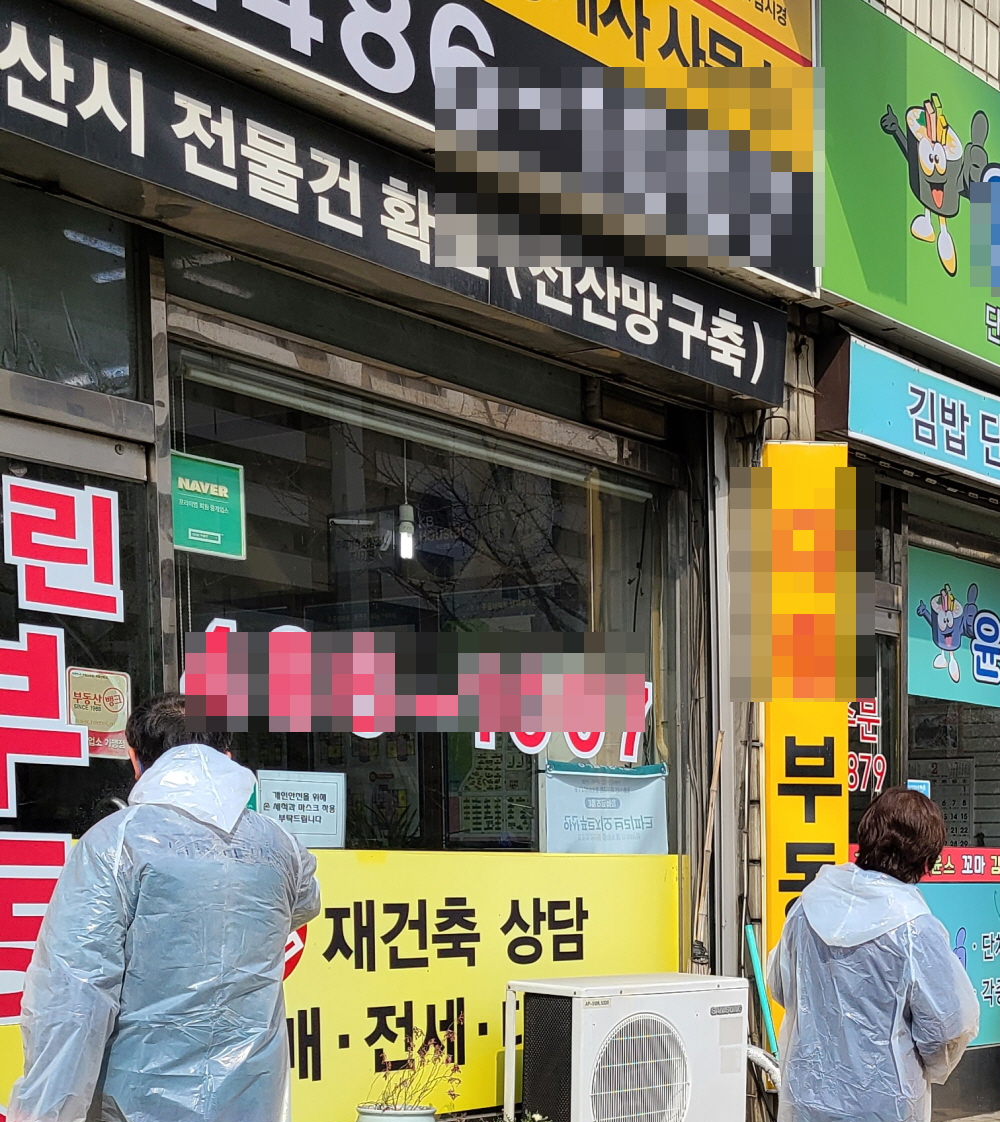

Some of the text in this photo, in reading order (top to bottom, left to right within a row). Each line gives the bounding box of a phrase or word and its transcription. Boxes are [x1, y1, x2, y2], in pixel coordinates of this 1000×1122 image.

[170, 91, 363, 238] 전물건
[906, 383, 971, 459] 김밥
[178, 476, 229, 498] NAVER
[73, 692, 122, 707] 부동산 뱅크
[312, 793, 326, 802] 위해
[298, 803, 319, 812] 마스크
[279, 814, 322, 824] 부탁드립니다
[962, 855, 985, 874] 꼬마
[322, 897, 589, 972] 재건축 상담
